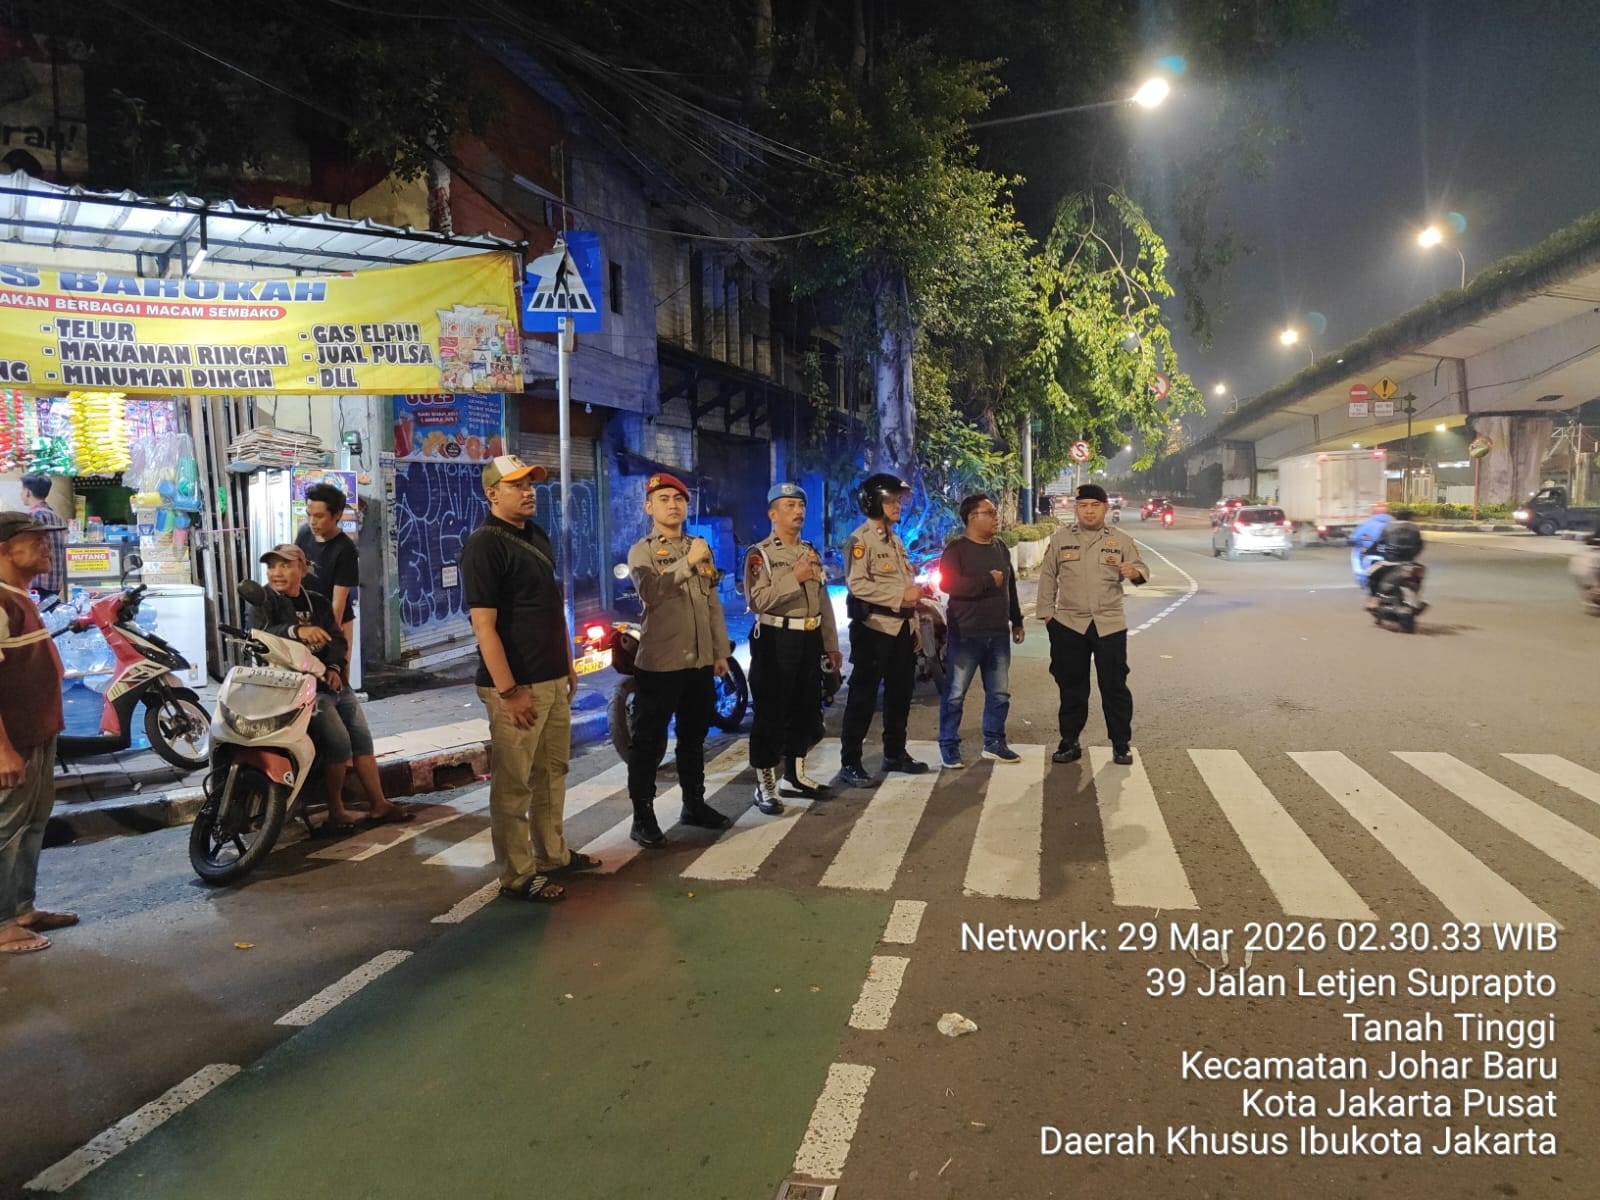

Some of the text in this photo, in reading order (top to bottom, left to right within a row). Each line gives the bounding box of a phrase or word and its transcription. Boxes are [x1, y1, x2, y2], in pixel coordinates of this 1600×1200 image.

[55, 298, 141, 315] BERBAGAI
[146, 305, 204, 317] MACAM
[208, 307, 280, 318] SEMBAKO
[56, 319, 135, 342] TELUR
[312, 325, 357, 344] GAS
[60, 341, 192, 365] MAKANAN
[197, 346, 287, 366] RINGAN
[316, 345, 368, 364] JUAL
[373, 344, 434, 364] PULSA
[62, 365, 187, 388] MINUMAN
[190, 369, 274, 388] DINGIN
[320, 368, 358, 388] DLL
